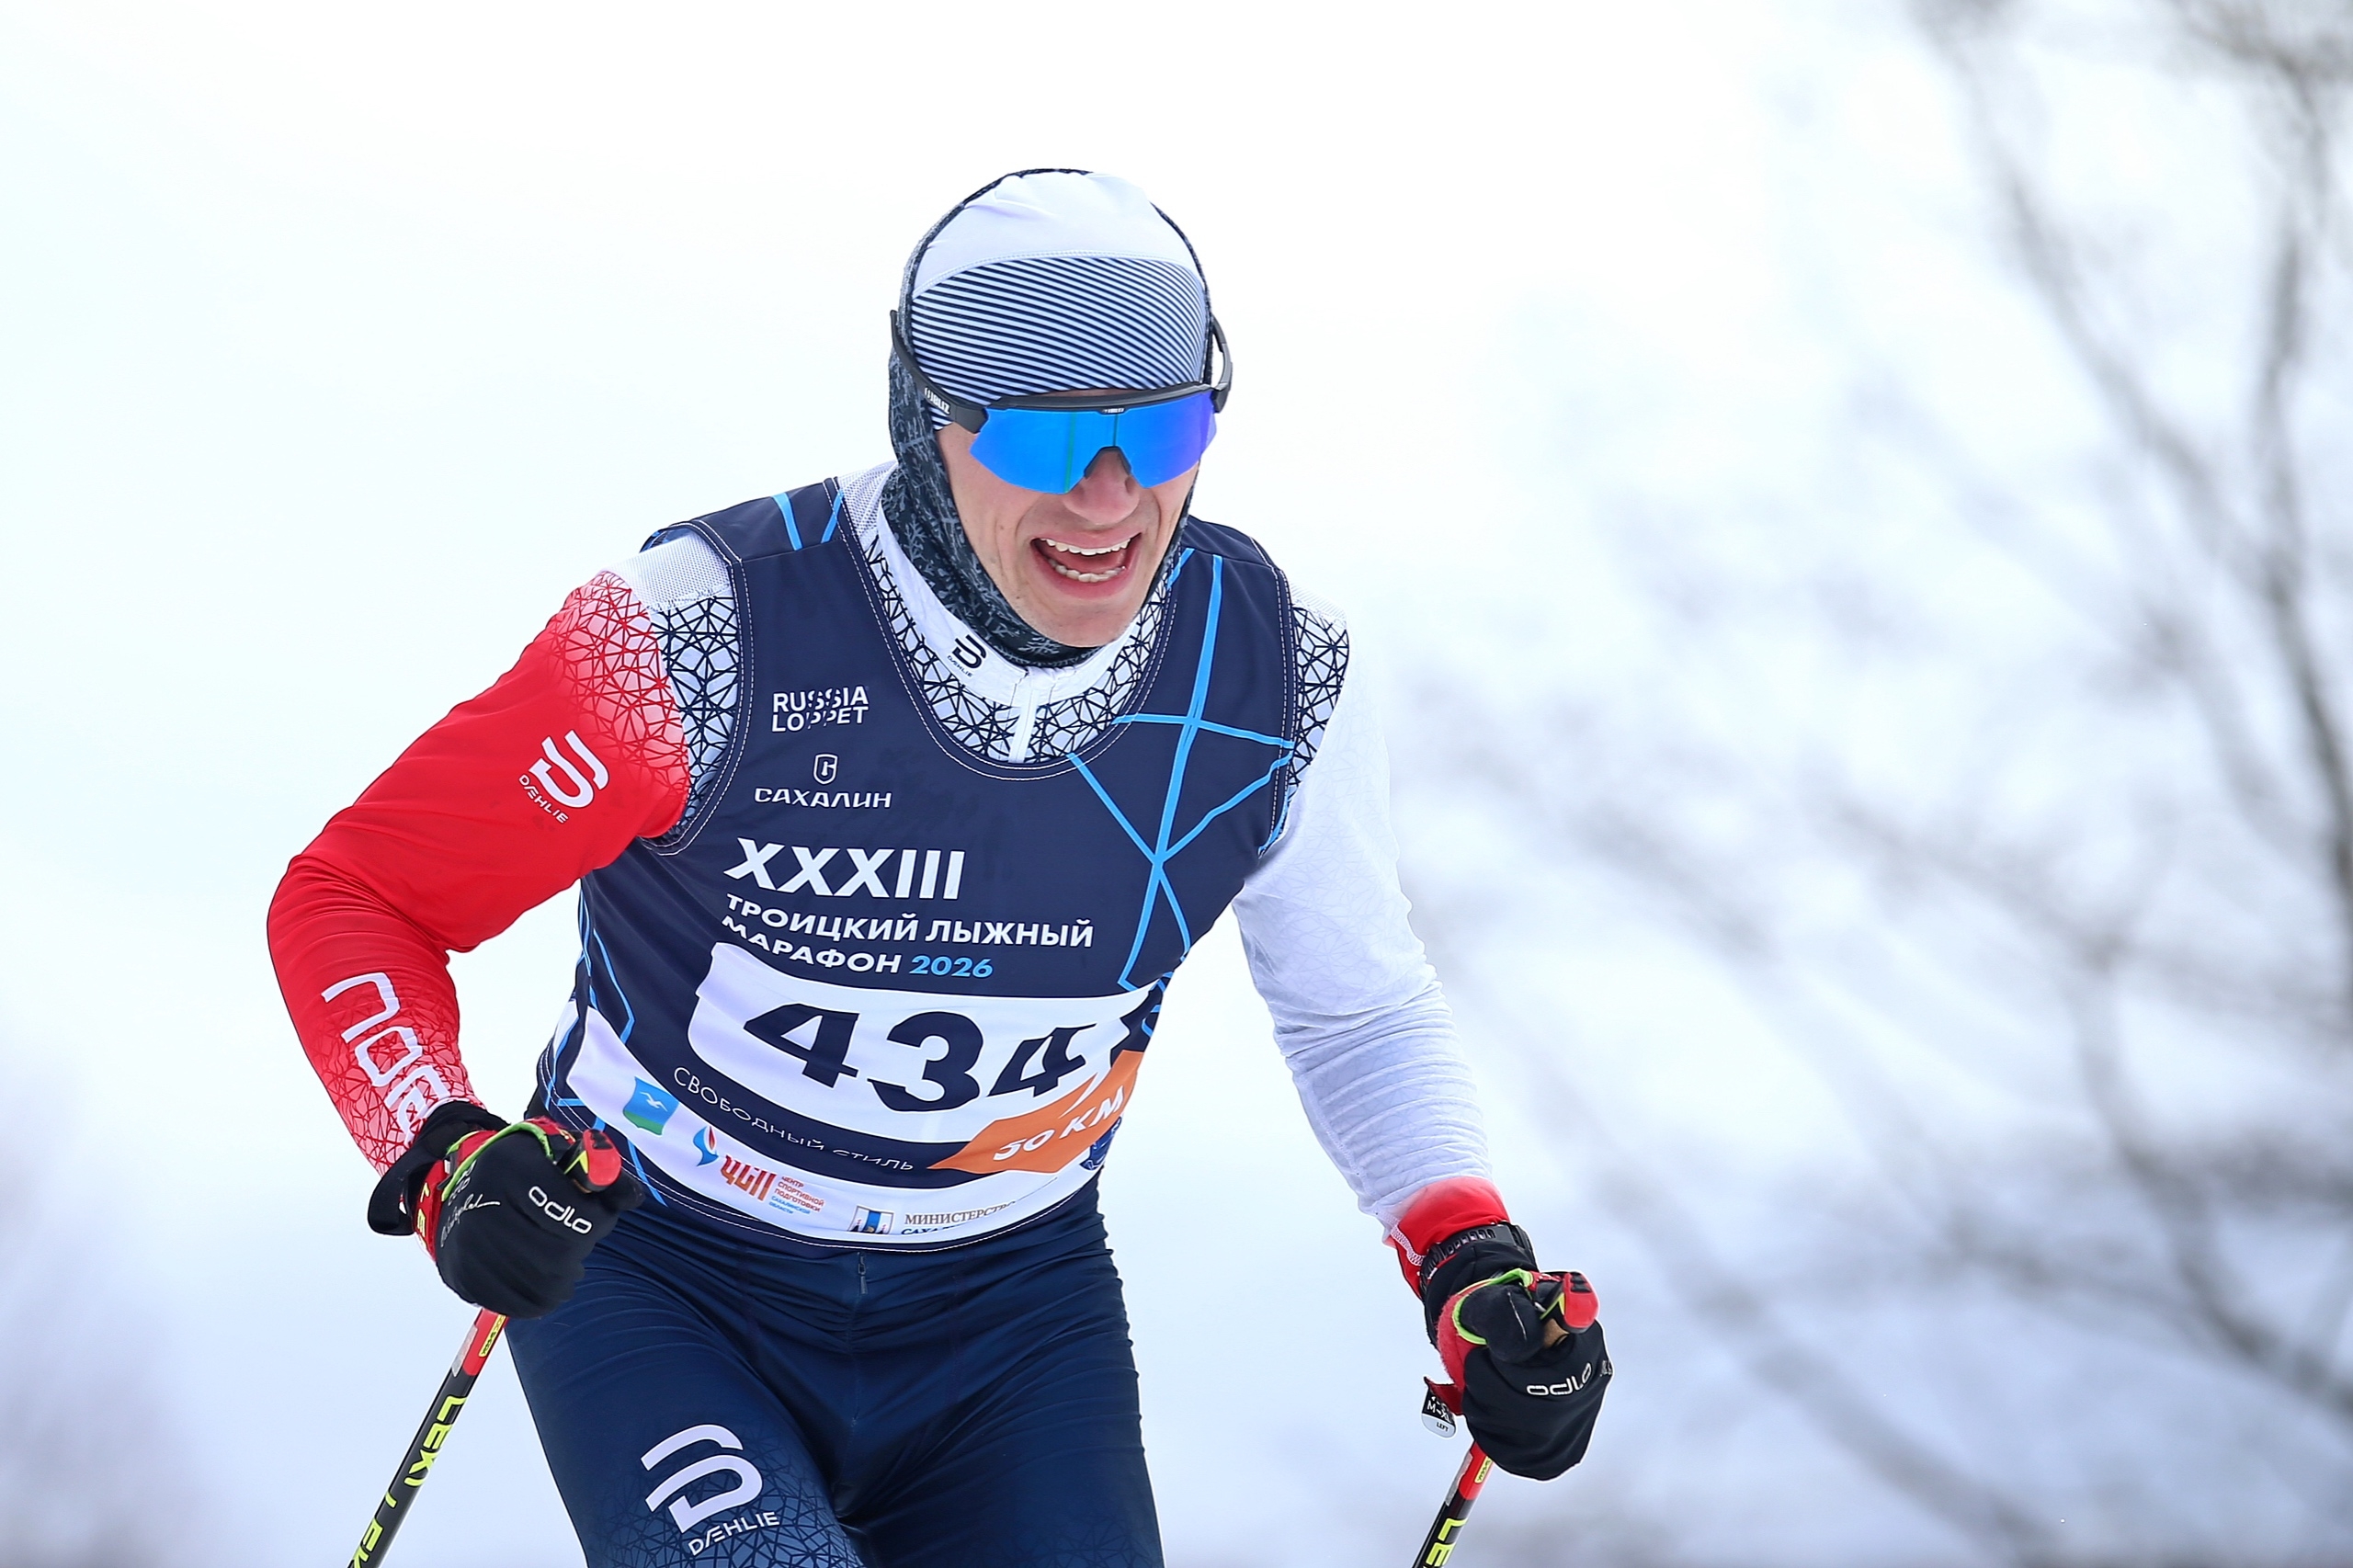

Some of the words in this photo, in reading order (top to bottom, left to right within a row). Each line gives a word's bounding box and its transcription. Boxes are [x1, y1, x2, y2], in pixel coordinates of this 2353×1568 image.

[772, 706, 870, 733] LOPPET
[773, 686, 870, 713] RUSSIA
[518, 774, 569, 824] DÆHLIE
[755, 788, 892, 808] САХАЛИН
[723, 837, 966, 900] XXXIII
[726, 892, 919, 942] ТРОИЦКИЙ
[925, 918, 1095, 948] ЛЫЖНЫЙ
[722, 915, 903, 973] МАРАФОН
[908, 955, 995, 978] 2026
[743, 1003, 1097, 1113] 434
[674, 1066, 824, 1151] СВОБОДНЫЙ
[833, 1149, 915, 1170] СТИЛЬ
[993, 1129, 1055, 1161] 50
[528, 1185, 593, 1234] odlo
[778, 1182, 824, 1207] СПОРТИВНОЙ
[1526, 1362, 1592, 1396] odlo
[688, 1511, 779, 1556] DÆHLIE
